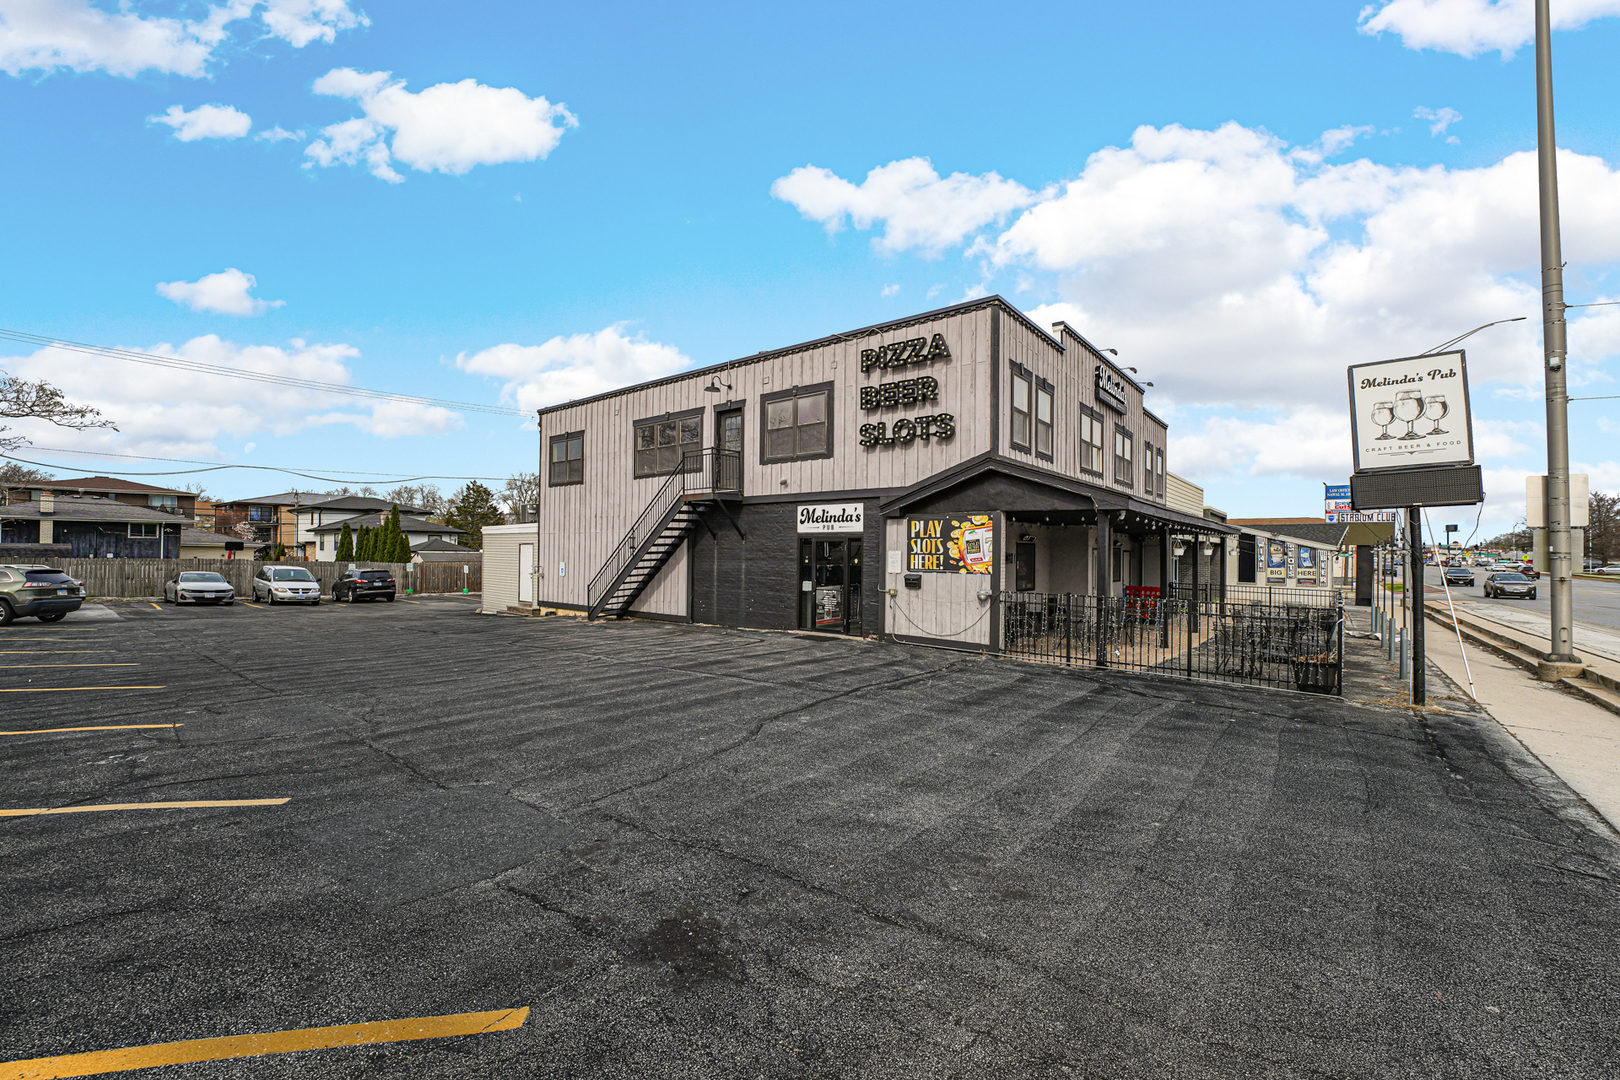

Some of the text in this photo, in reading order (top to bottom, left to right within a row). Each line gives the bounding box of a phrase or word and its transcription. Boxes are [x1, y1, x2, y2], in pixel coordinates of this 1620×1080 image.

[861, 333, 951, 373] PIZZA
[1360, 368, 1457, 389] Melinda's Pub
[860, 376, 939, 410] BEER
[859, 413, 955, 446] SLOTS
[1365, 445, 1393, 453] CRAFT
[800, 506, 862, 525] Melinda's
[1376, 513, 1396, 522] CLUB
[911, 520, 943, 538] PLAY
[910, 538, 944, 554] SLOTS
[910, 554, 944, 570] HERE!
